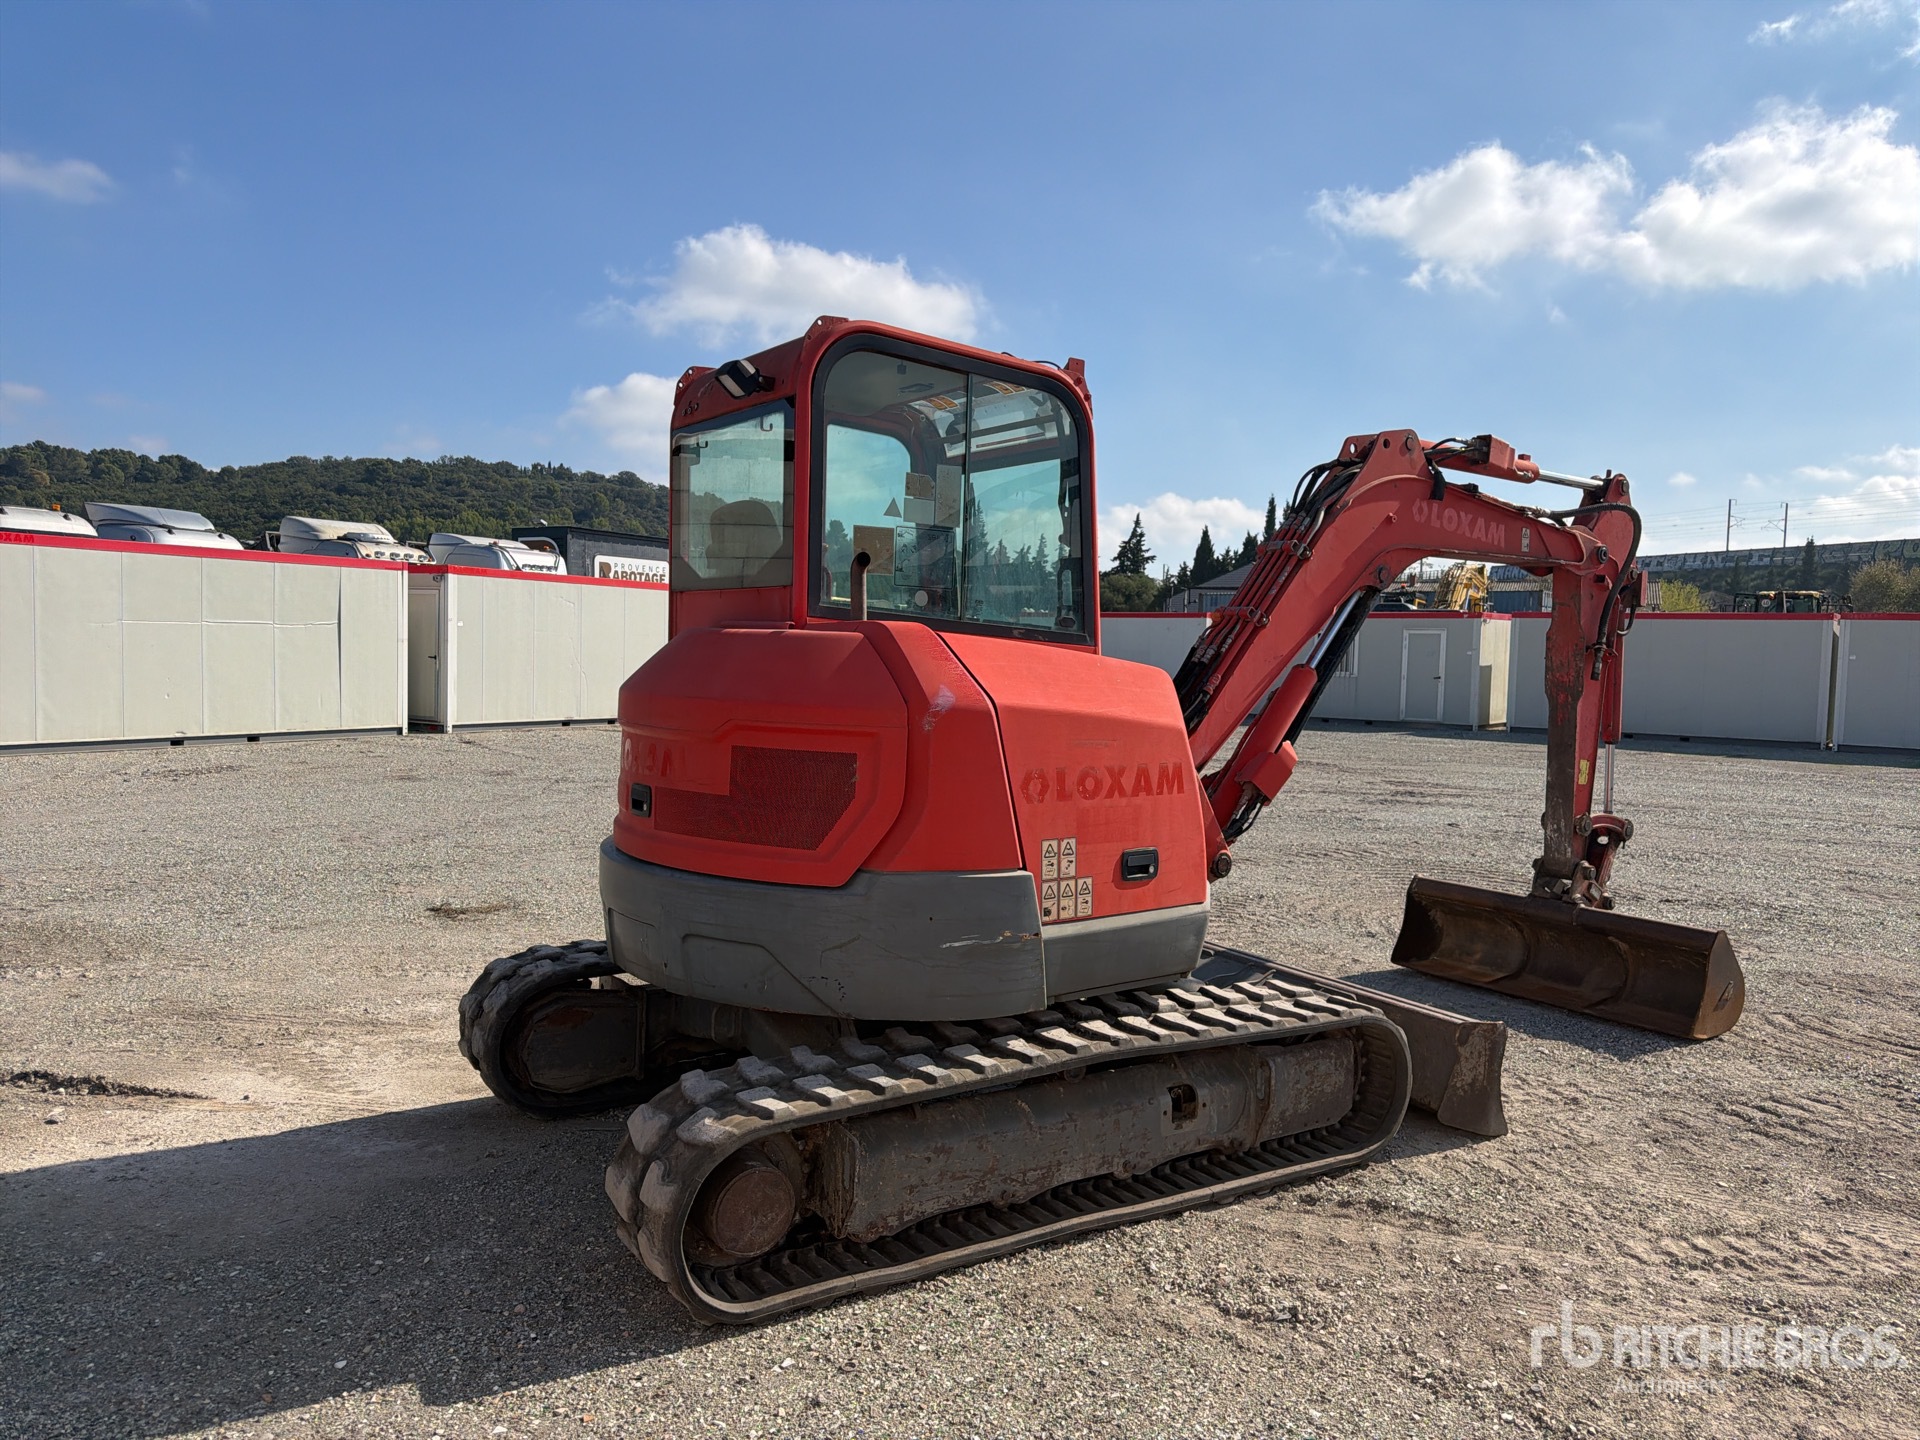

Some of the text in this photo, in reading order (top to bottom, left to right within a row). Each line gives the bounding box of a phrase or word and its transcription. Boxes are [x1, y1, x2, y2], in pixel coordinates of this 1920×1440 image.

[1431, 502, 1505, 548] LOXAM
[613, 562, 667, 573] PROVENCE
[1056, 762, 1185, 802] LOXAM
